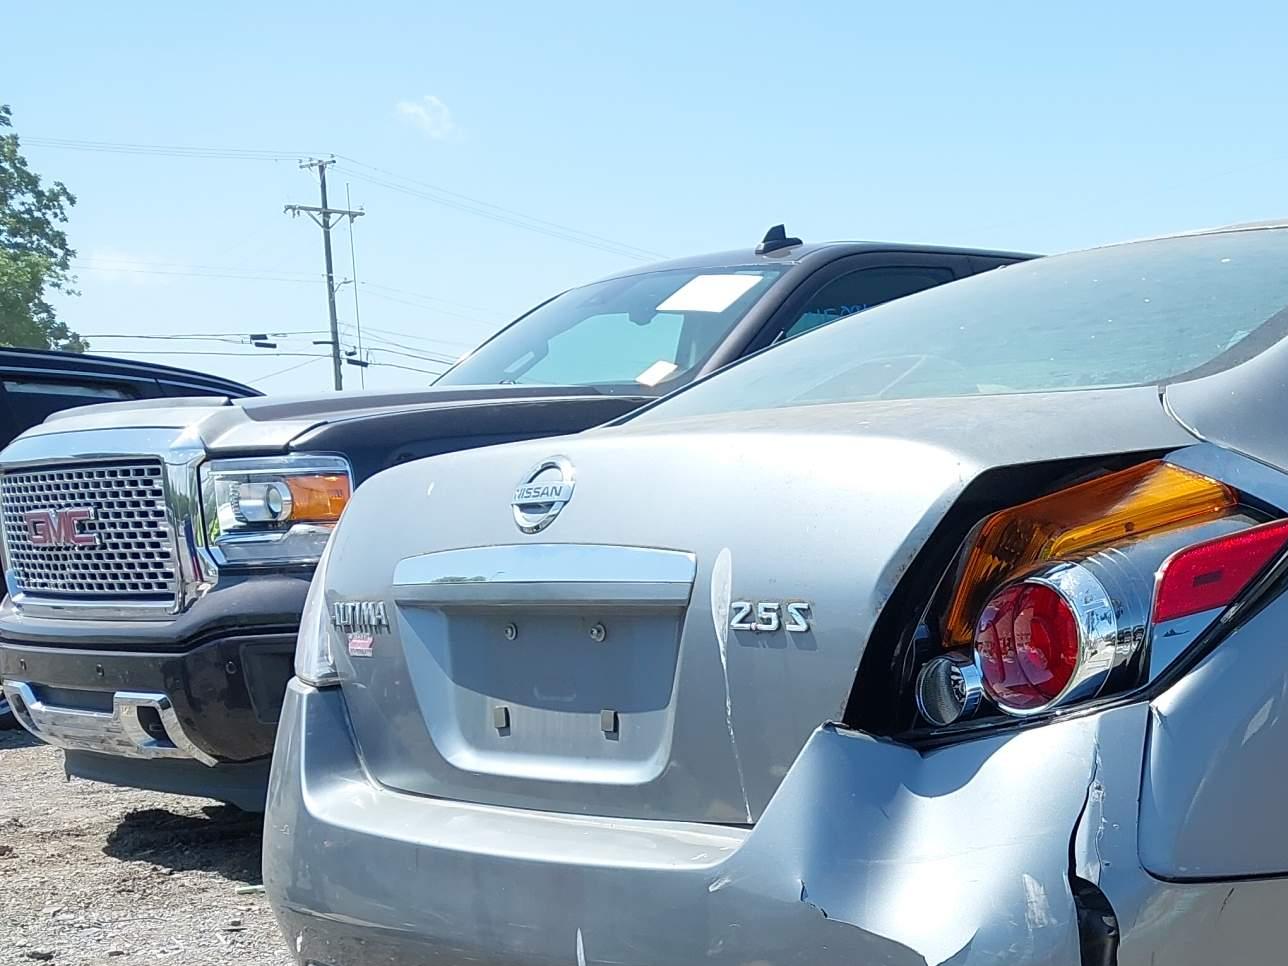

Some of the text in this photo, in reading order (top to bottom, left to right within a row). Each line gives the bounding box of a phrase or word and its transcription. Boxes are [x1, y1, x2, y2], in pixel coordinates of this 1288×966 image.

[514, 486, 562, 499] NISSAN
[25, 507, 100, 545] GMC
[786, 602, 809, 631] S
